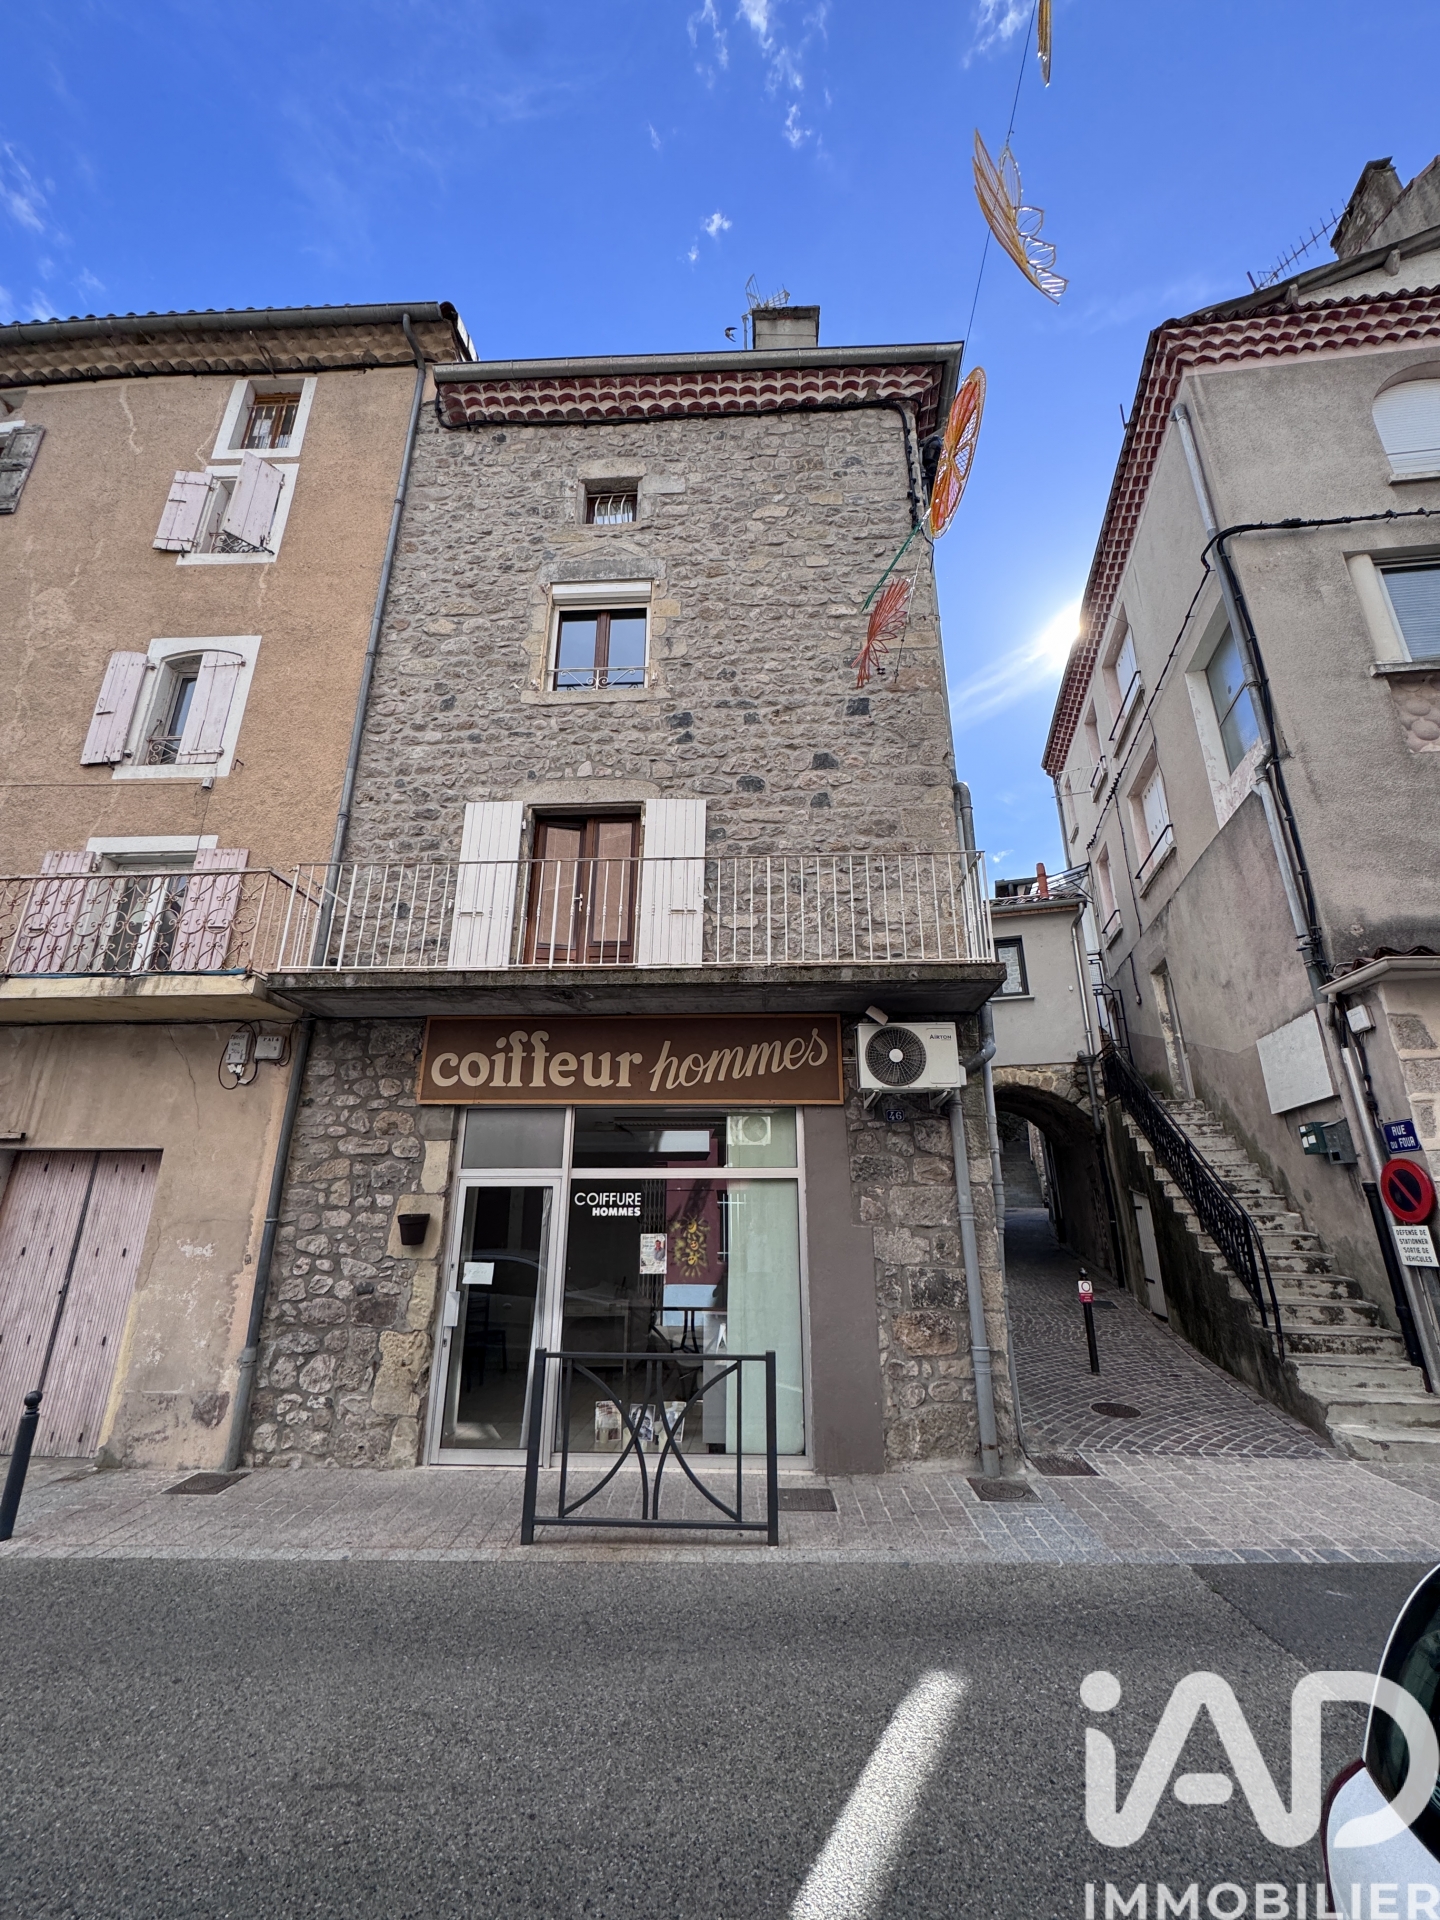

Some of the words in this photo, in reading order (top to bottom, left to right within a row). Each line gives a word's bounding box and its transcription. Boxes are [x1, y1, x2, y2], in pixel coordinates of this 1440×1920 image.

[431, 1030, 643, 1088] coiffeur
[649, 1028, 828, 1091] hommes
[888, 1111, 903, 1121] 46
[1390, 1124, 1407, 1137] RUE
[1389, 1140, 1399, 1149] DU
[1398, 1136, 1416, 1149] FOUR
[574, 1192, 642, 1206] COIFFURE
[592, 1207, 641, 1216] HOMMES
[1403, 1246, 1421, 1254] SORTIE
